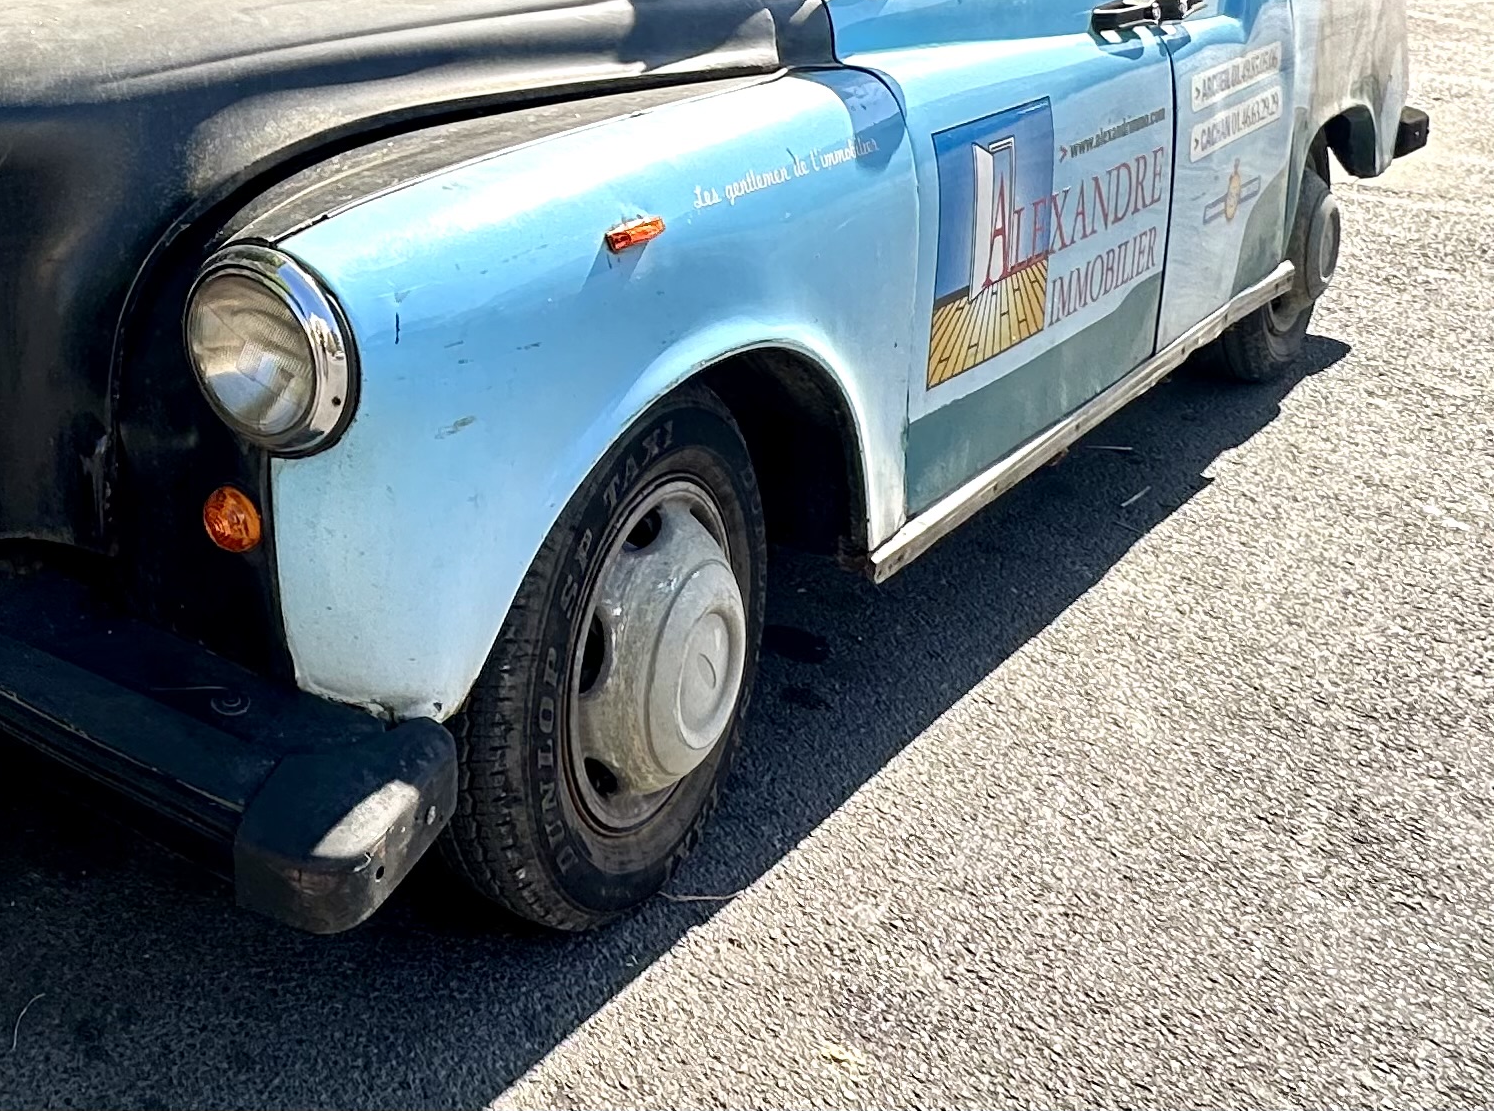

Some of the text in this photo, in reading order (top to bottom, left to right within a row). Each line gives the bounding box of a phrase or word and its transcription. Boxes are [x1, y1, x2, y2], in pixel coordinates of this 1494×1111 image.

[693, 185, 722, 209] Les
[724, 166, 792, 205] gentlemen
[793, 154, 810, 177] de
[982, 146, 1165, 288] ALEXANDRE
[1048, 226, 1158, 328] IMMOBILIER
[536, 646, 580, 876] DUNLOP
